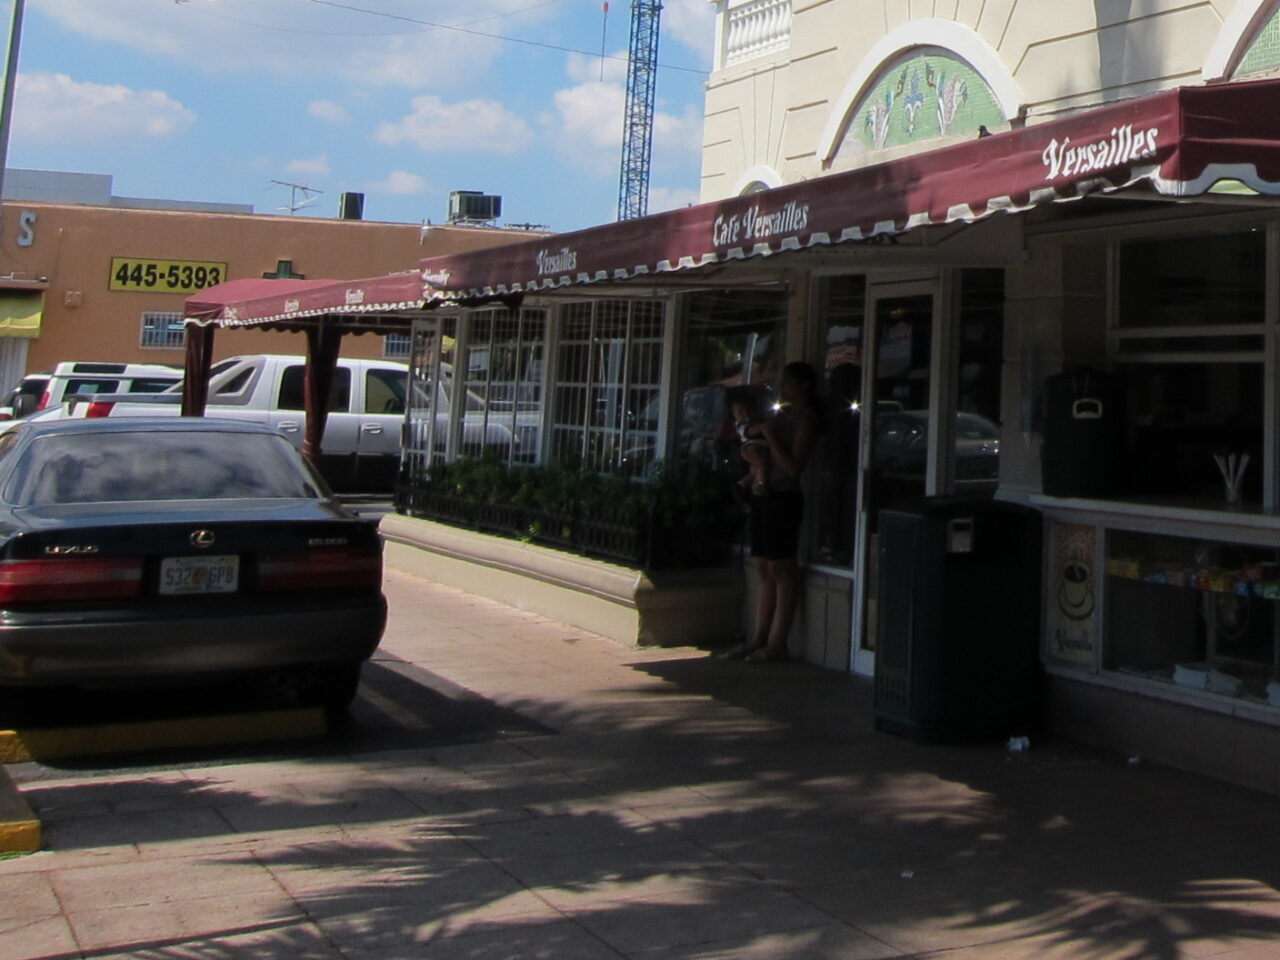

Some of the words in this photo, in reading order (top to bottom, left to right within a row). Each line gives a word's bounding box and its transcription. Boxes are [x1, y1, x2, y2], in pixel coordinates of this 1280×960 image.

[1042, 123, 1159, 181] Versailles
[712, 214, 739, 247] Cafe
[742, 200, 811, 240] Versailles
[114, 261, 221, 289] 445-5393
[535, 246, 578, 276] Versailles
